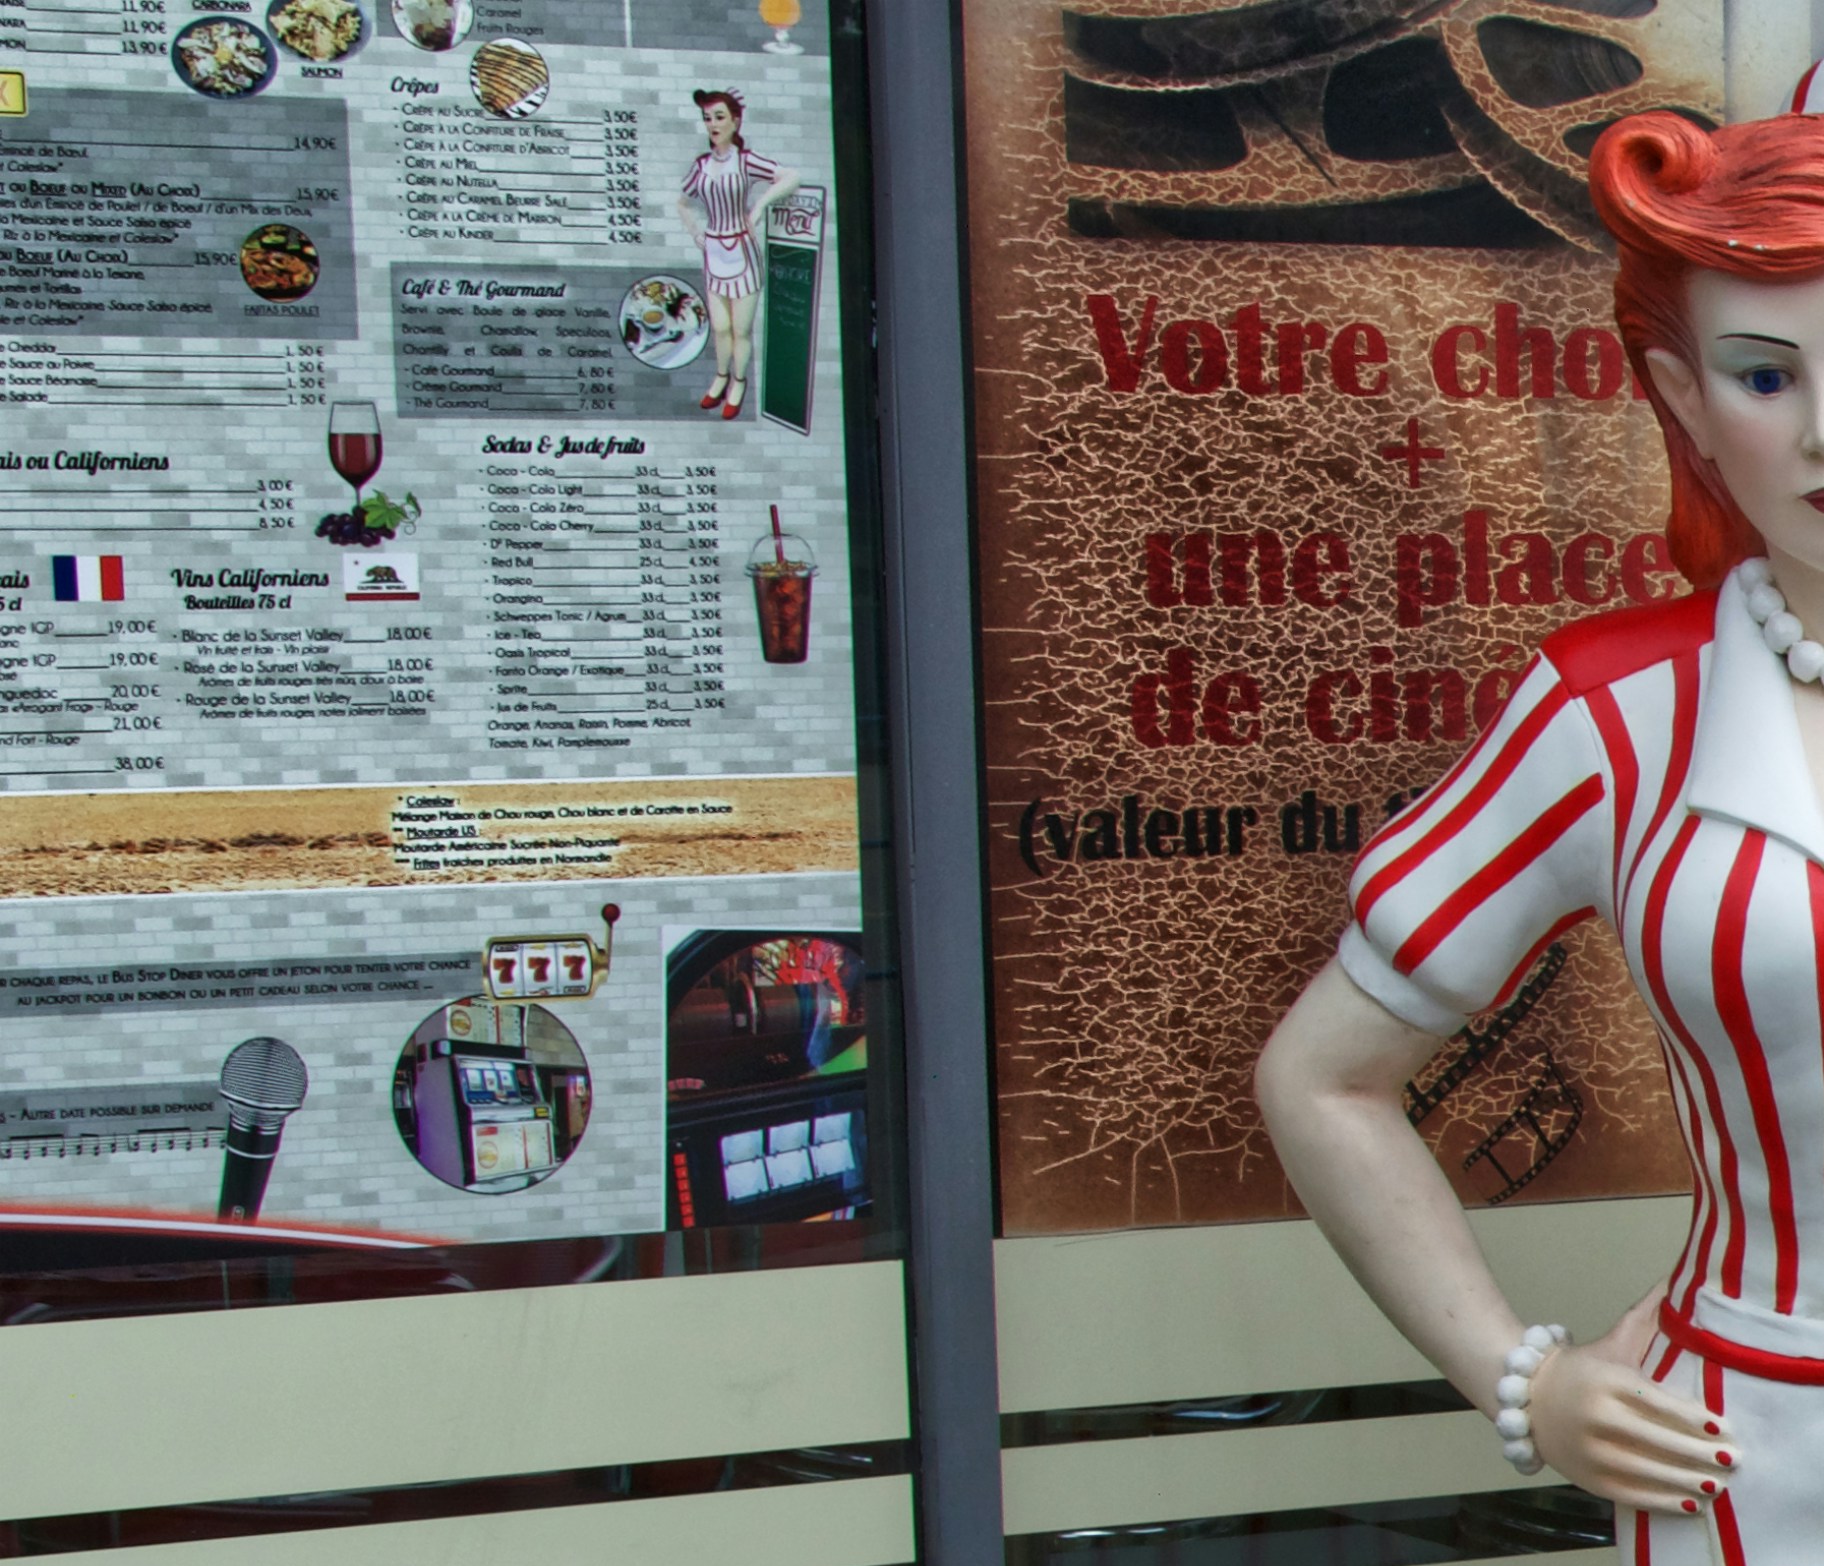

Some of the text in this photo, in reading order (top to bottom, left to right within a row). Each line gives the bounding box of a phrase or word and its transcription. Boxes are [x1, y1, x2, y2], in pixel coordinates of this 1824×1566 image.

[391, 77, 439, 97] Crêpes
[402, 278, 566, 300] Café & Thé Gourmand
[1086, 293, 1657, 401] Votre cho
[482, 434, 532, 454] Sodas
[536, 436, 553, 454] &
[25, 453, 49, 471] ou
[54, 450, 170, 476] Californiens
[170, 567, 331, 592] Vins Californiens
[1143, 509, 1677, 629] une place
[183, 593, 292, 611] Bouteilles 75 cl
[181, 628, 219, 642] Blanc
[223, 628, 241, 642] de
[244, 628, 257, 641] la
[260, 627, 302, 642] Sunset
[305, 627, 344, 644] Valley
[219, 660, 238, 674] de
[241, 660, 254, 673] la
[257, 660, 299, 674] Sunset
[302, 659, 342, 676] Valley
[1129, 648, 1262, 751] de
[1279, 789, 1360, 853] du
